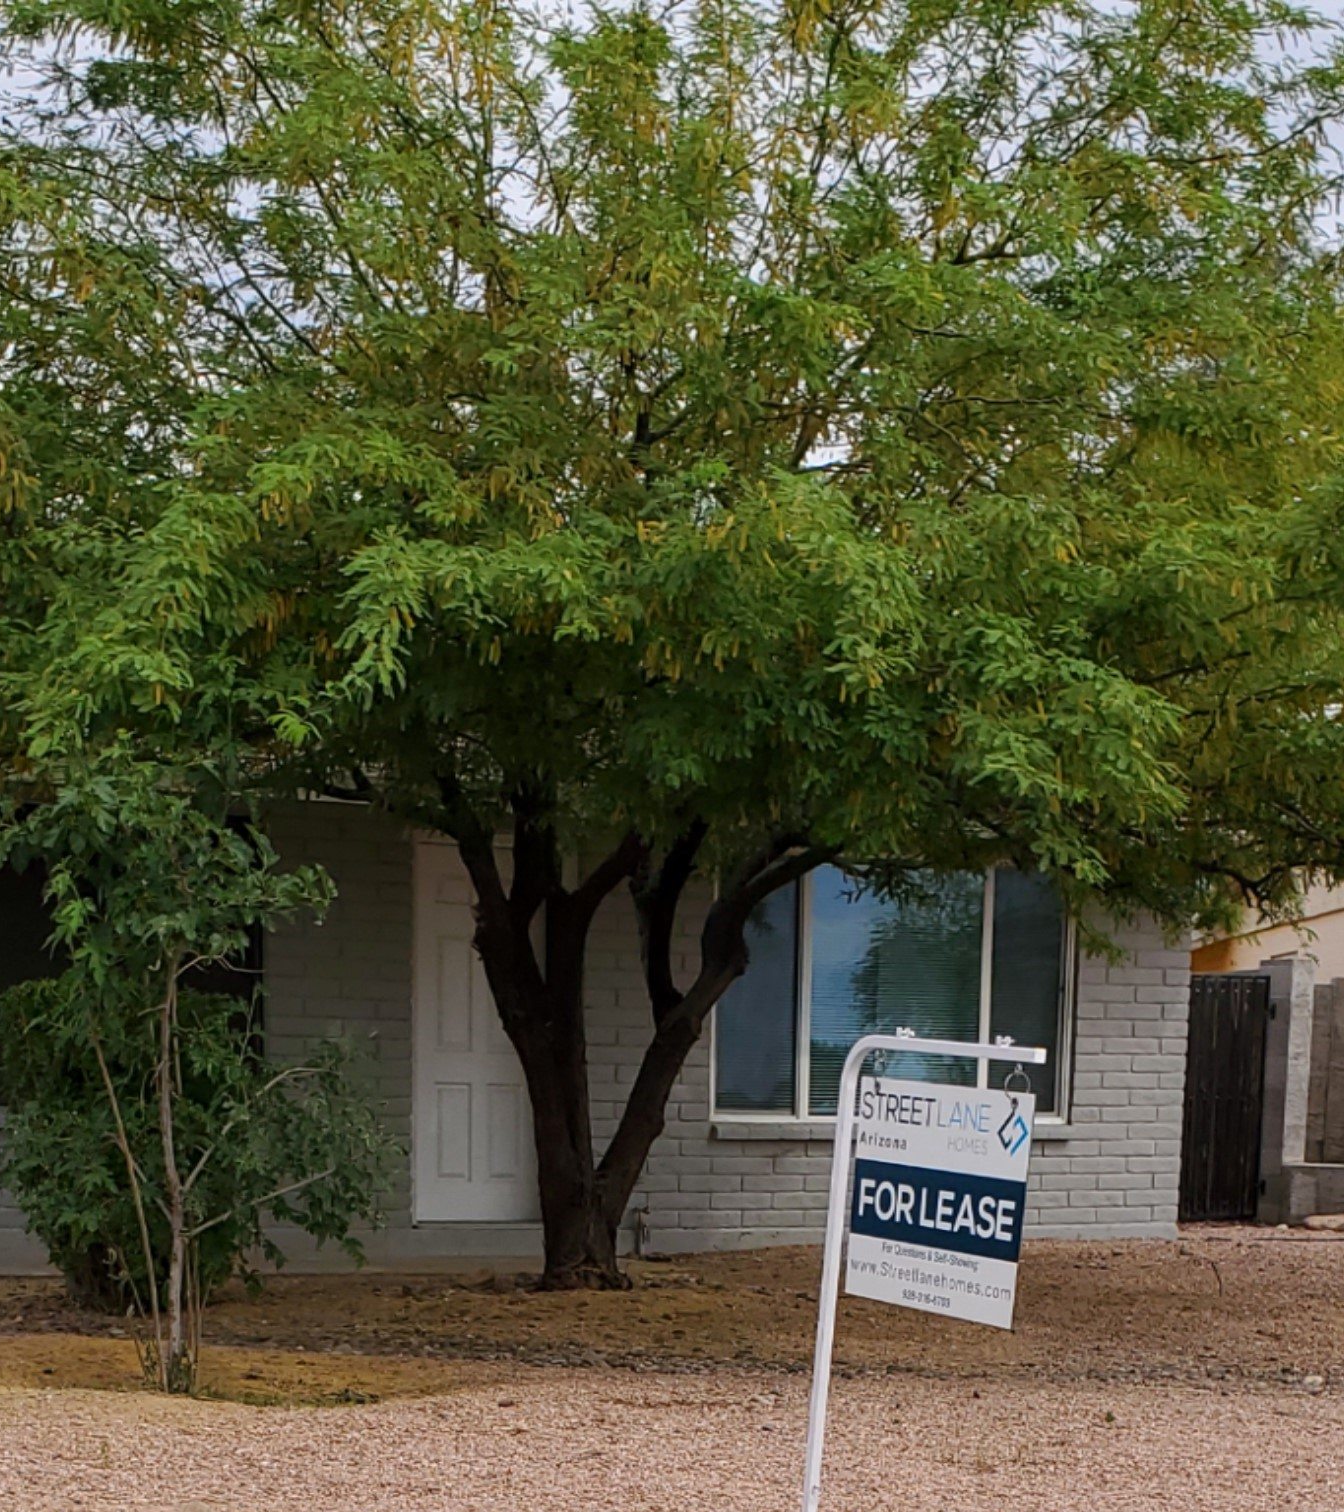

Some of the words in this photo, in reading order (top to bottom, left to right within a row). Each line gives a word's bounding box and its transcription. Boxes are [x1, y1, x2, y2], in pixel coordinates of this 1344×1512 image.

[862, 1091, 936, 1127] STREET
[937, 1100, 992, 1133] LANE
[859, 1131, 907, 1150] Arizona
[947, 1136, 988, 1155] HOMES
[858, 1178, 915, 1225] FOR
[919, 1187, 1016, 1242] LEASE
